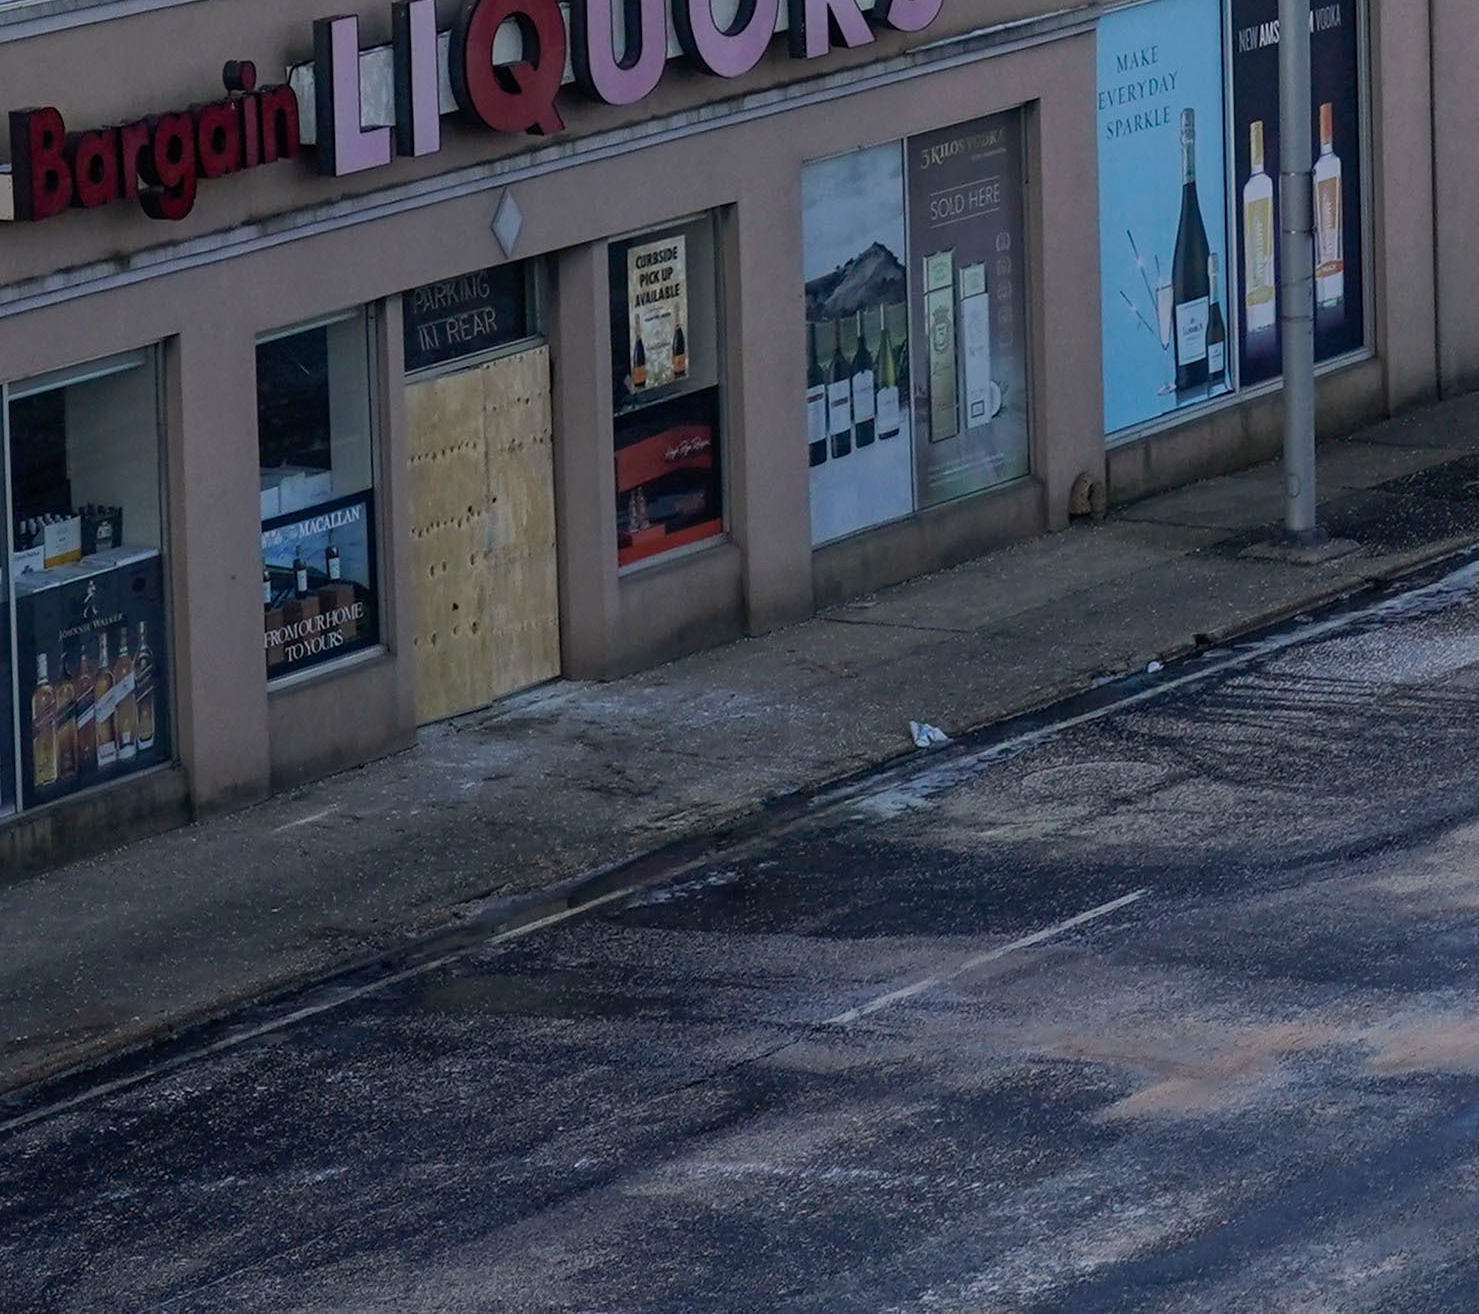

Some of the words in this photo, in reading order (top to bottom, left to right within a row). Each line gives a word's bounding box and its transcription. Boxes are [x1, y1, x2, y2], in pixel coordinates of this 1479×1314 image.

[1315, 2, 1342, 33] VODKA
[1238, 26, 1259, 54] NEW
[1115, 44, 1160, 75] MAKE
[1097, 71, 1179, 111] EVERYDAY
[1105, 105, 1171, 140] SPARKLE
[11, 59, 300, 221] Bargain
[929, 193, 965, 221] SOLD
[968, 184, 1001, 210] HERE
[635, 246, 678, 270] CURBSIDE
[413, 271, 490, 314] PARKING
[639, 269, 661, 288] PICK
[660, 266, 674, 281] UP
[634, 282, 681, 308] AVAILABLE
[417, 322, 440, 352] IN
[447, 307, 499, 344] REAR
[299, 505, 361, 537] MACALLAN
[264, 625, 299, 649] FROM
[298, 613, 327, 637] OUR
[325, 601, 364, 629] HOME
[284, 643, 305, 663] TO
[303, 629, 344, 655] YOURS
